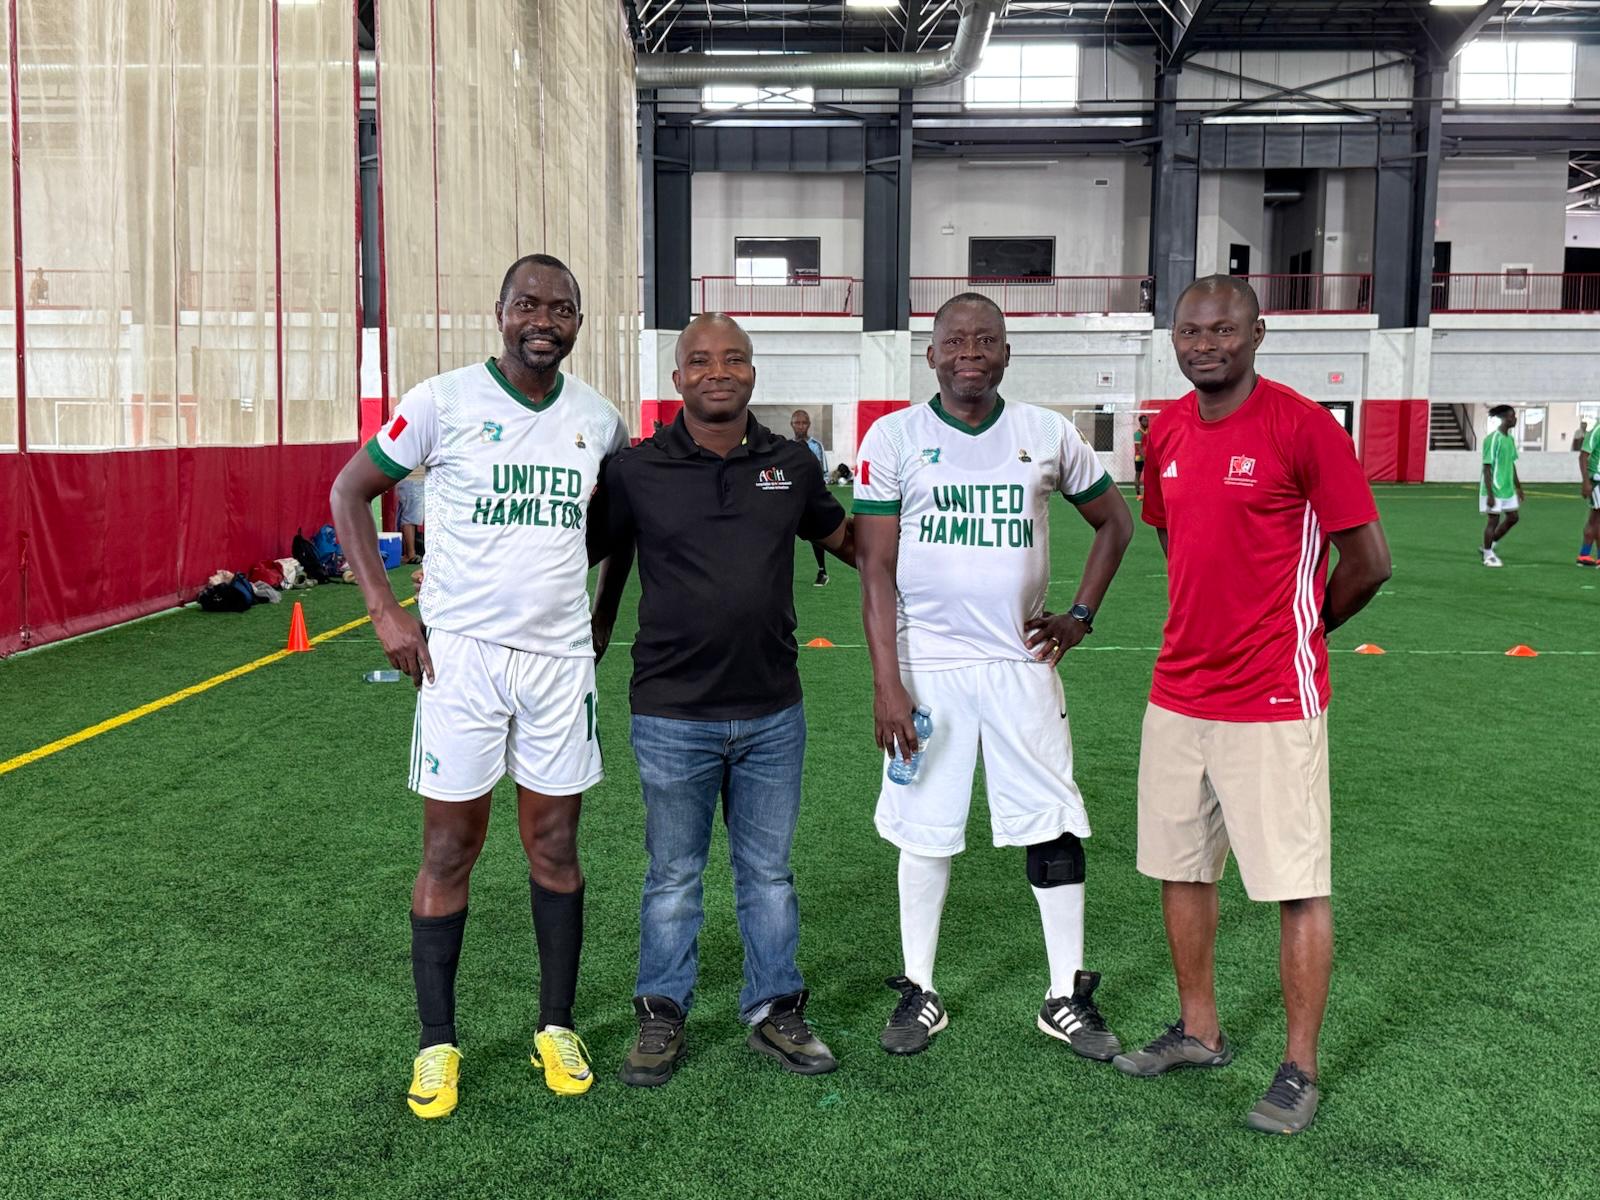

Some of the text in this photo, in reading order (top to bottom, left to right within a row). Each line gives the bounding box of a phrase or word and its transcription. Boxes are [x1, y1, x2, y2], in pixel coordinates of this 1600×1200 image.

[493, 464, 582, 498] UNITED
[472, 497, 582, 529] HAMILTON
[932, 484, 1024, 514] UNITED
[919, 515, 1034, 548] HAMILTON
